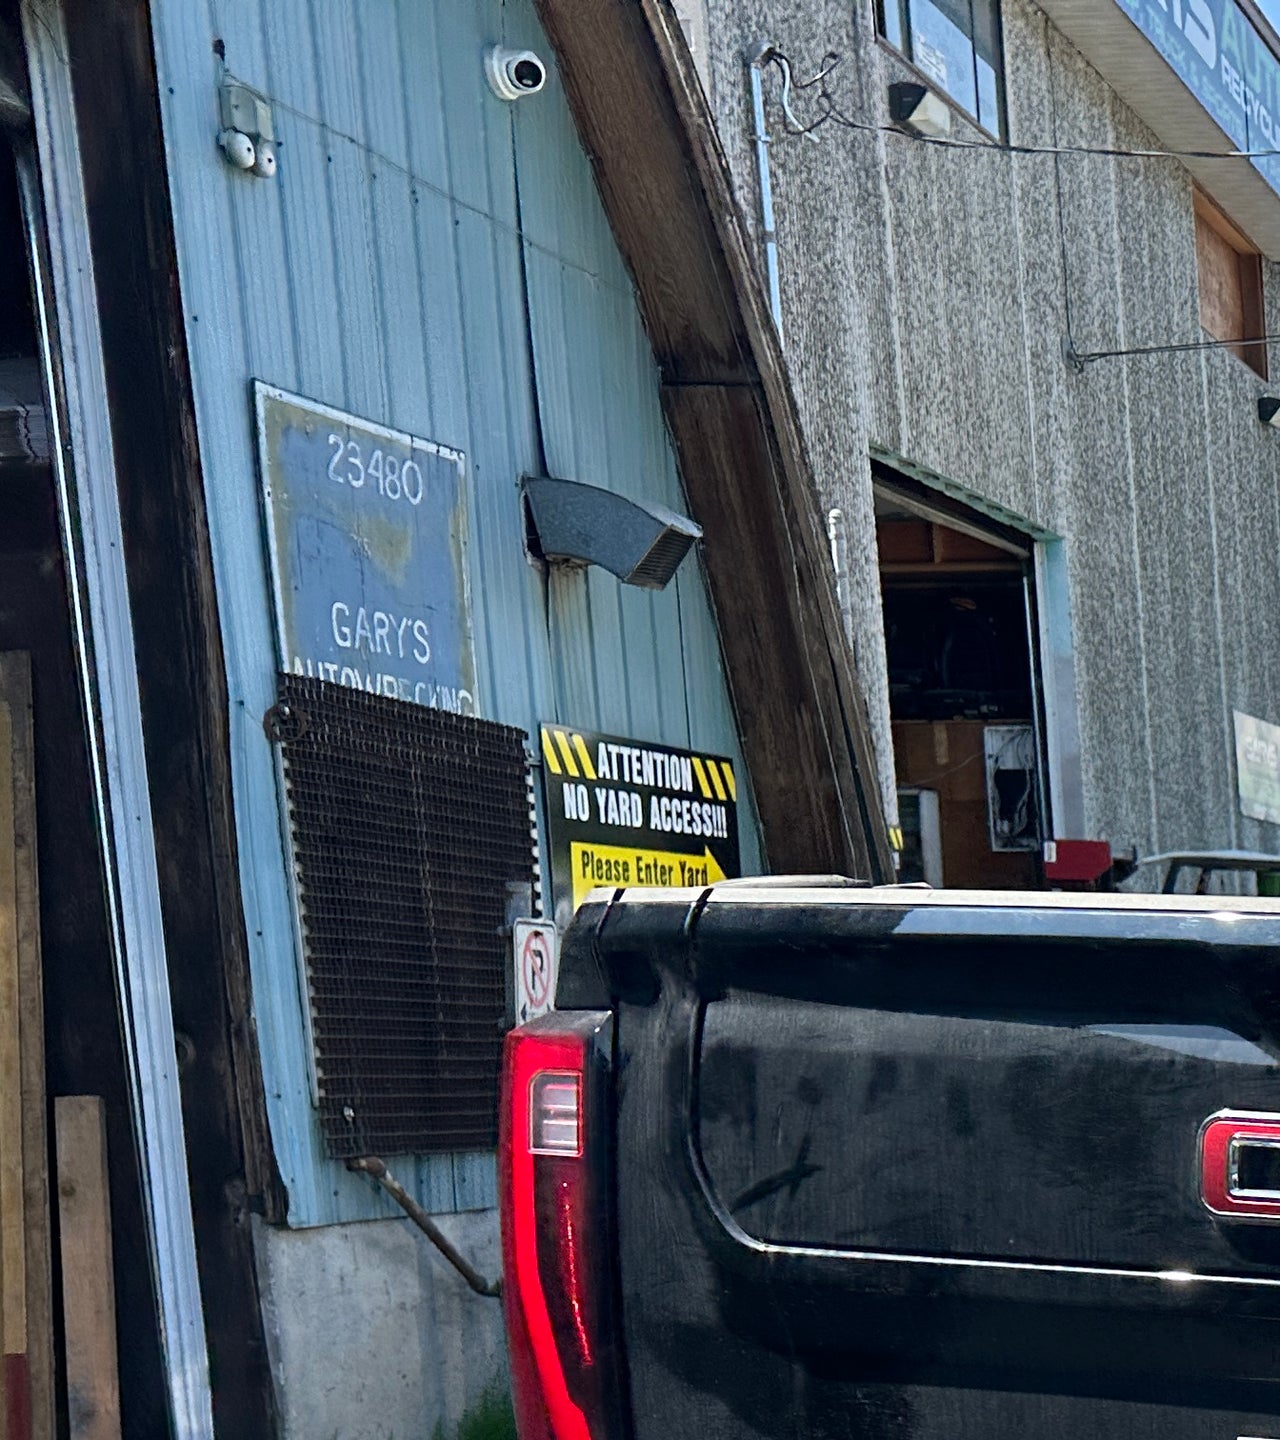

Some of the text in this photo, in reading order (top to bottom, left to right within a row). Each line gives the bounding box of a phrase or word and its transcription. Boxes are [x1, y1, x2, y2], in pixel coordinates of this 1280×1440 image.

[327, 433, 423, 506] 23480
[331, 601, 431, 665] GARY'S
[597, 742, 694, 793] ATTENTION
[562, 782, 728, 839] NO YARD ACCESS!!!
[581, 850, 709, 887] Please Enter Yard
